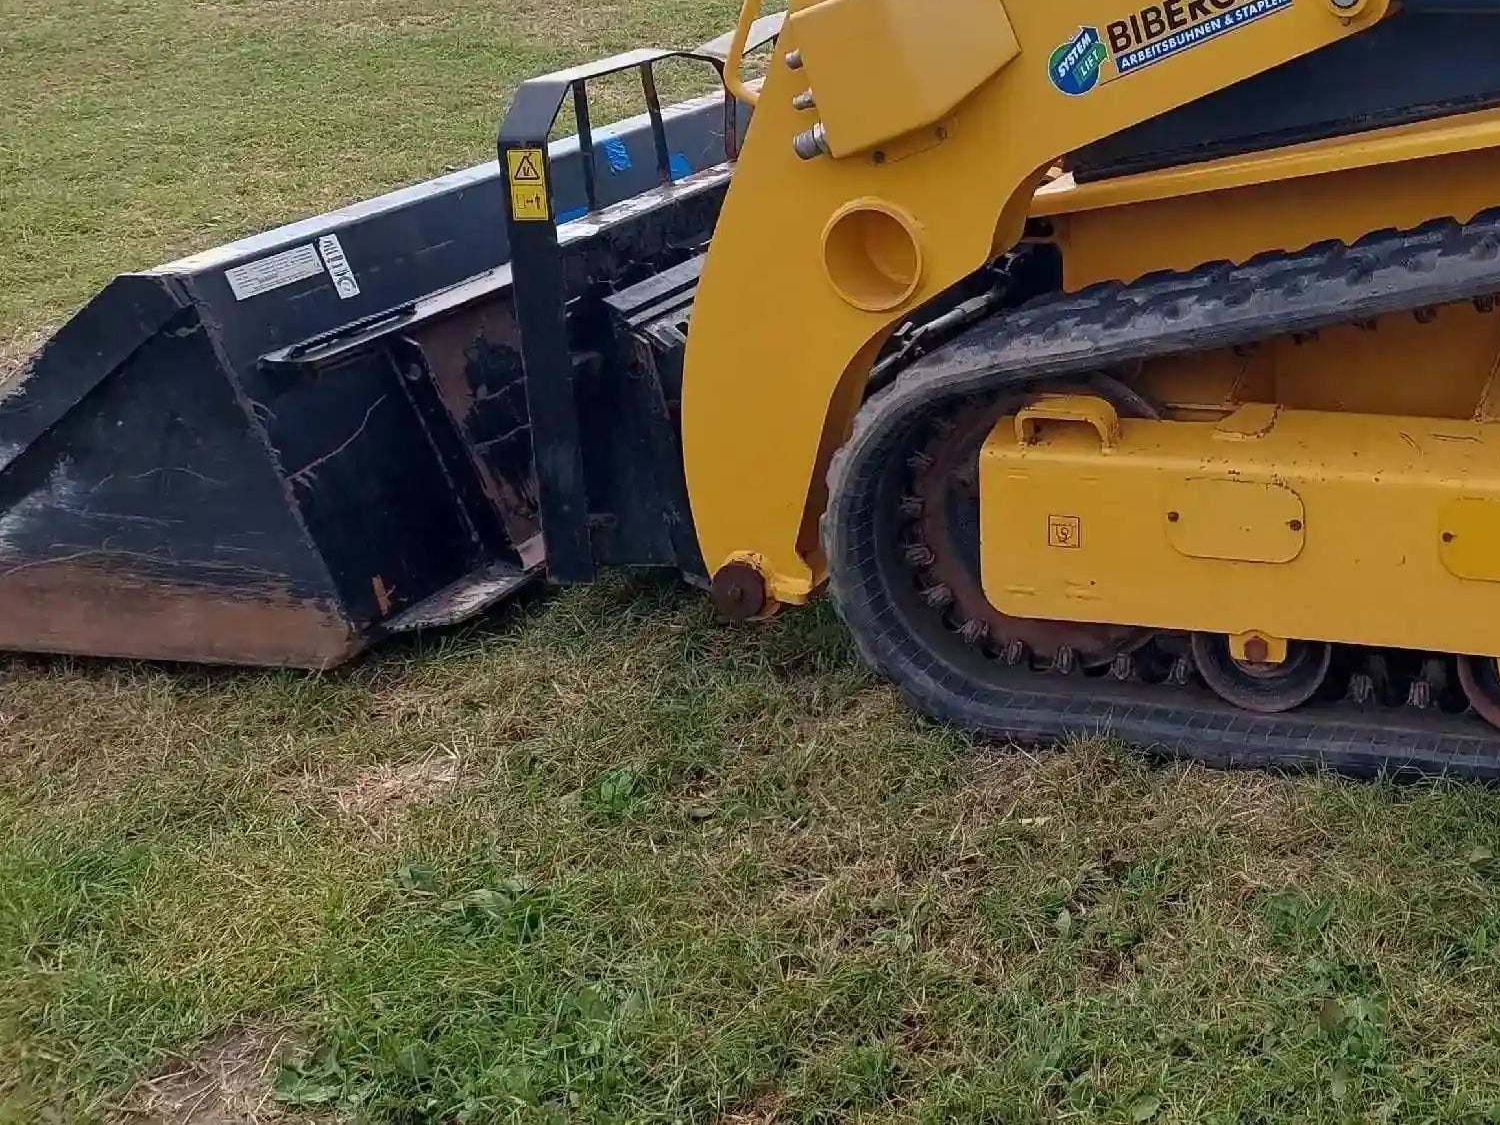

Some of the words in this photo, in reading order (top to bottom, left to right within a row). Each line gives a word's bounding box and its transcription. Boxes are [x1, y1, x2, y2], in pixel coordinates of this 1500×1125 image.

[1224, 12, 1235, 26] &
[1057, 31, 1092, 78] SYSTEM
[1080, 48, 1100, 77] LIFT
